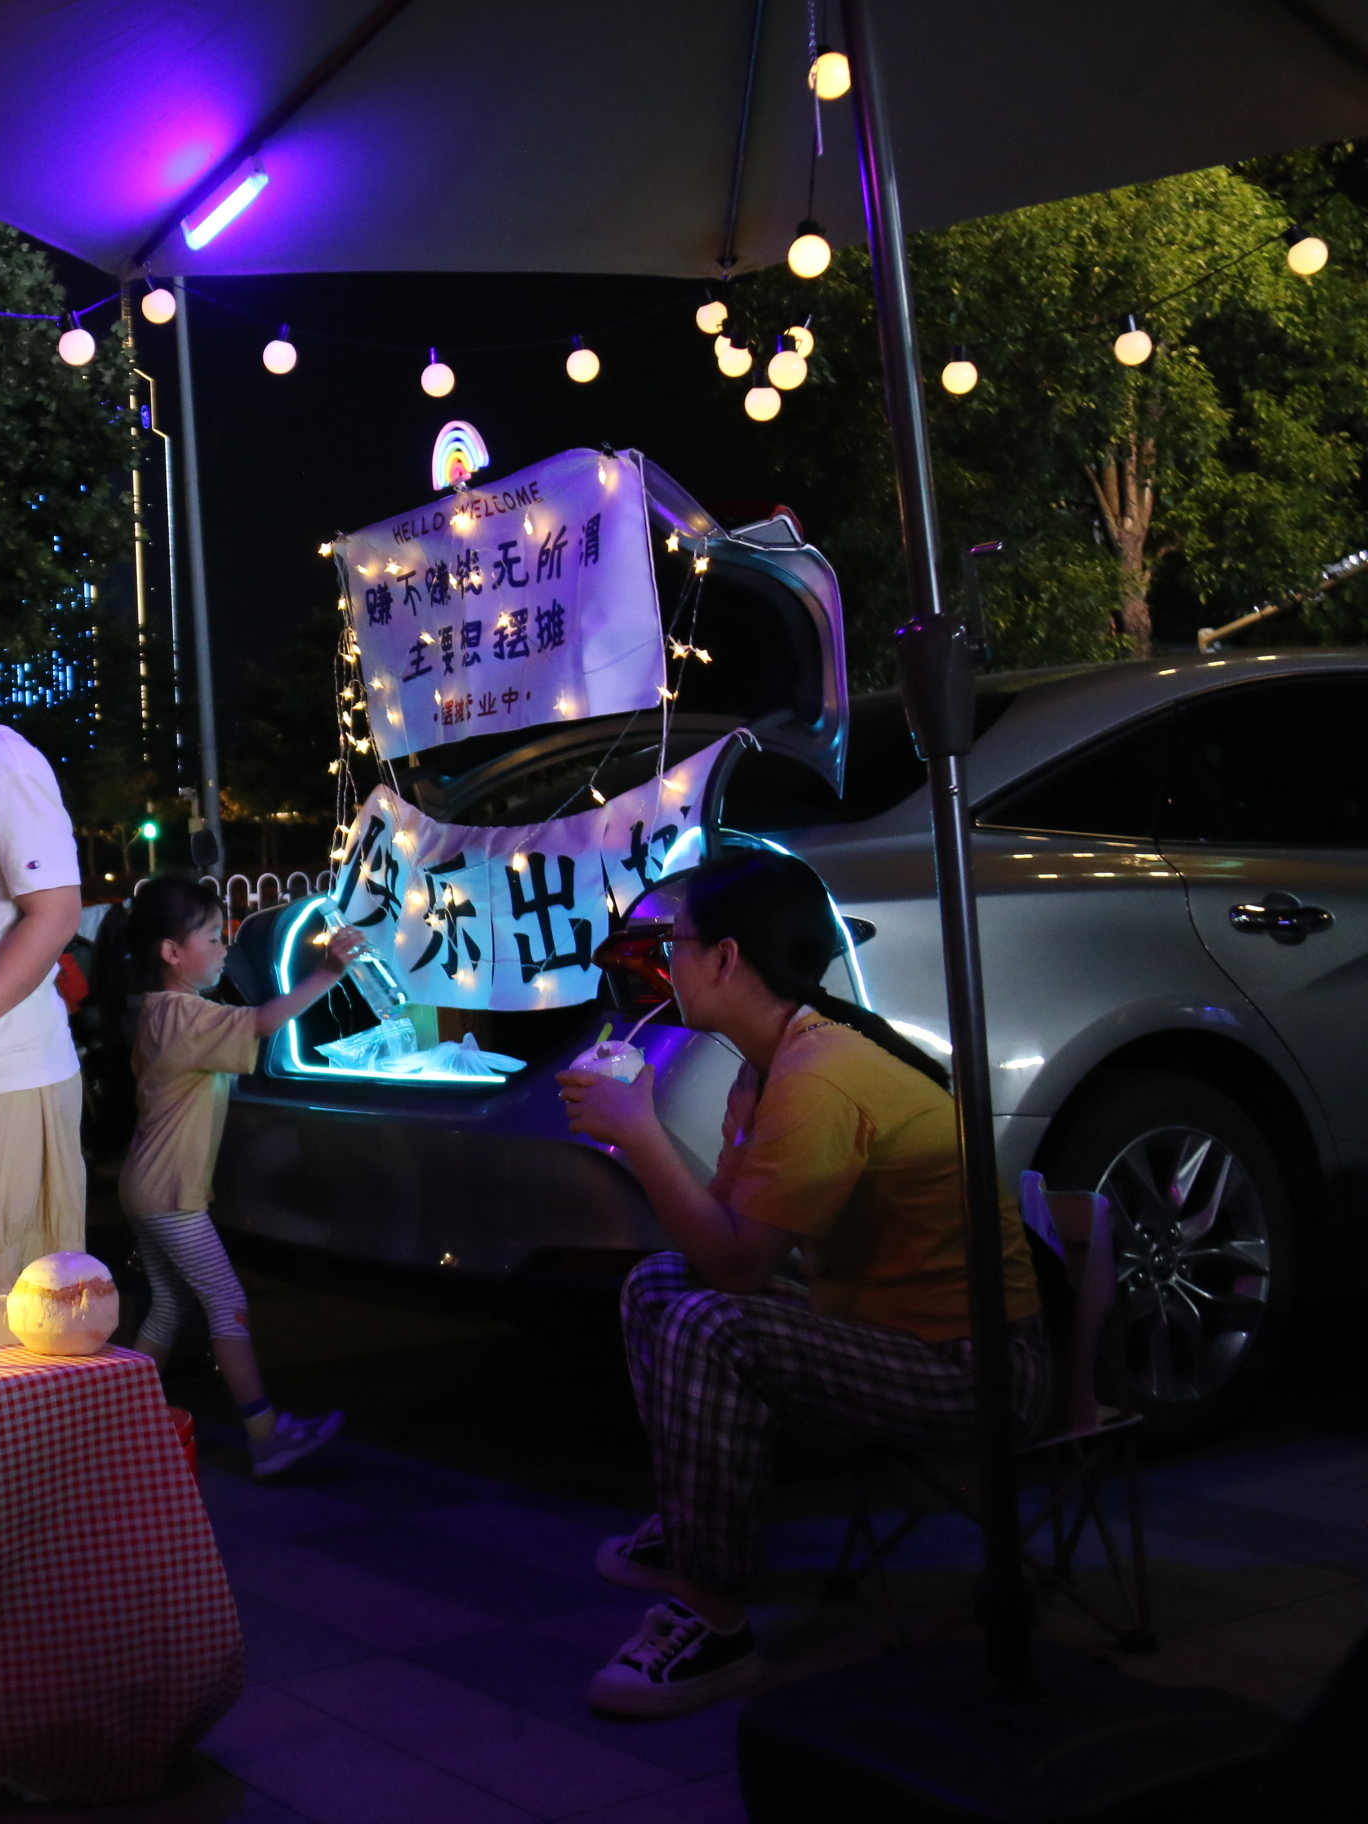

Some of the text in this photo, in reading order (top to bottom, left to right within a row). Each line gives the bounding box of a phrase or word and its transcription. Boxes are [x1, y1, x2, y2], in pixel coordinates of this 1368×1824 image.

[392, 481, 544, 545] HELLO WELCOME
[402, 598, 566, 683] 主要想摆摊
